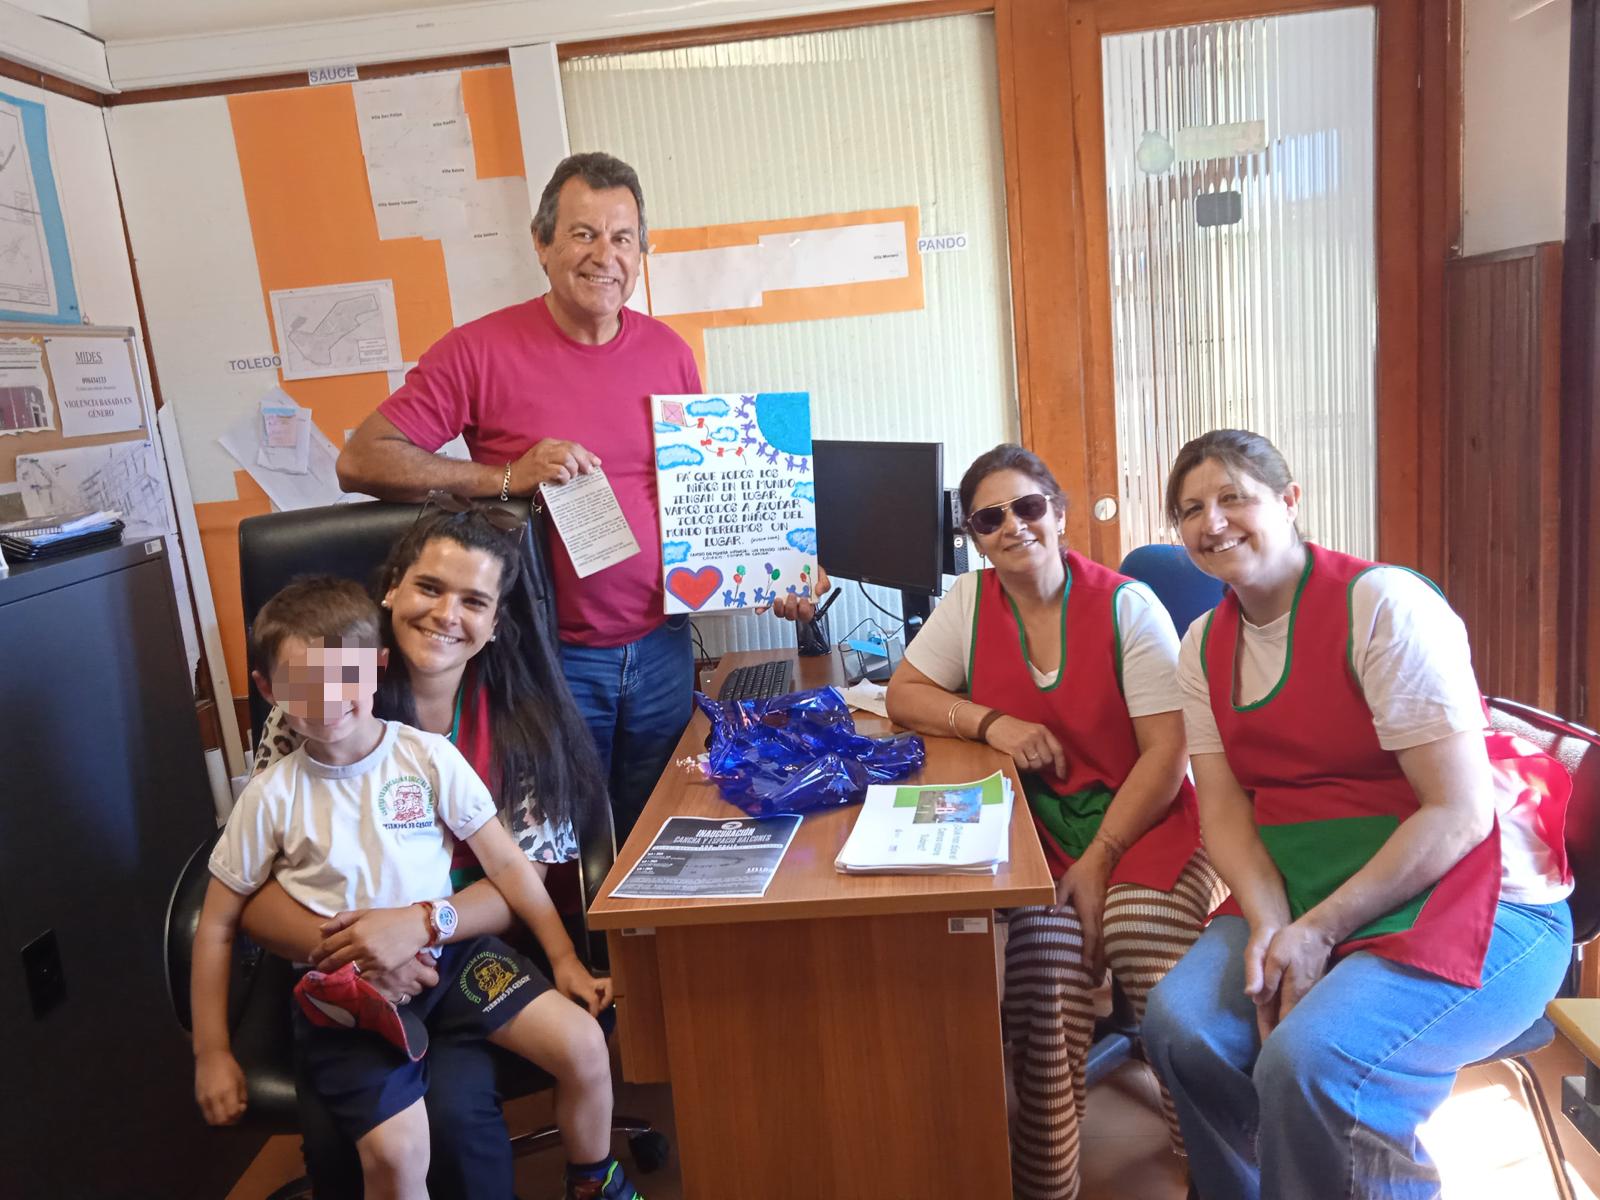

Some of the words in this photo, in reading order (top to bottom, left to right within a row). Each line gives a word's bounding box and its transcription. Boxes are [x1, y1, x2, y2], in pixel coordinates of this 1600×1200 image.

[310, 66, 356, 82] SAUCE
[918, 236, 967, 252] PANDO
[75, 351, 103, 363] MIDES
[229, 355, 282, 371] TOLEDO
[64, 399, 99, 409] VIOLENCIA
[694, 472, 716, 482] QUE
[721, 469, 754, 480] TODOS
[760, 469, 779, 479] LOS
[722, 482, 736, 492] EN
[741, 481, 752, 491] EL
[756, 478, 796, 490] MUNDO
[673, 493, 715, 505] TENGAN
[721, 493, 736, 502] UN
[743, 490, 782, 501] LUGAR,
[665, 504, 700, 516] VAMOS
[704, 502, 738, 514] TODOS
[742, 502, 750, 512] A
[756, 499, 801, 511] AYUDAR
[678, 514, 714, 526] TODOS
[718, 513, 738, 524] LOS
[783, 510, 804, 520] DEL
[666, 527, 702, 538] MUNDO
[706, 522, 763, 536] MERECEMOS
[770, 521, 788, 532] UN
[704, 535, 744, 547] LUGAR.
